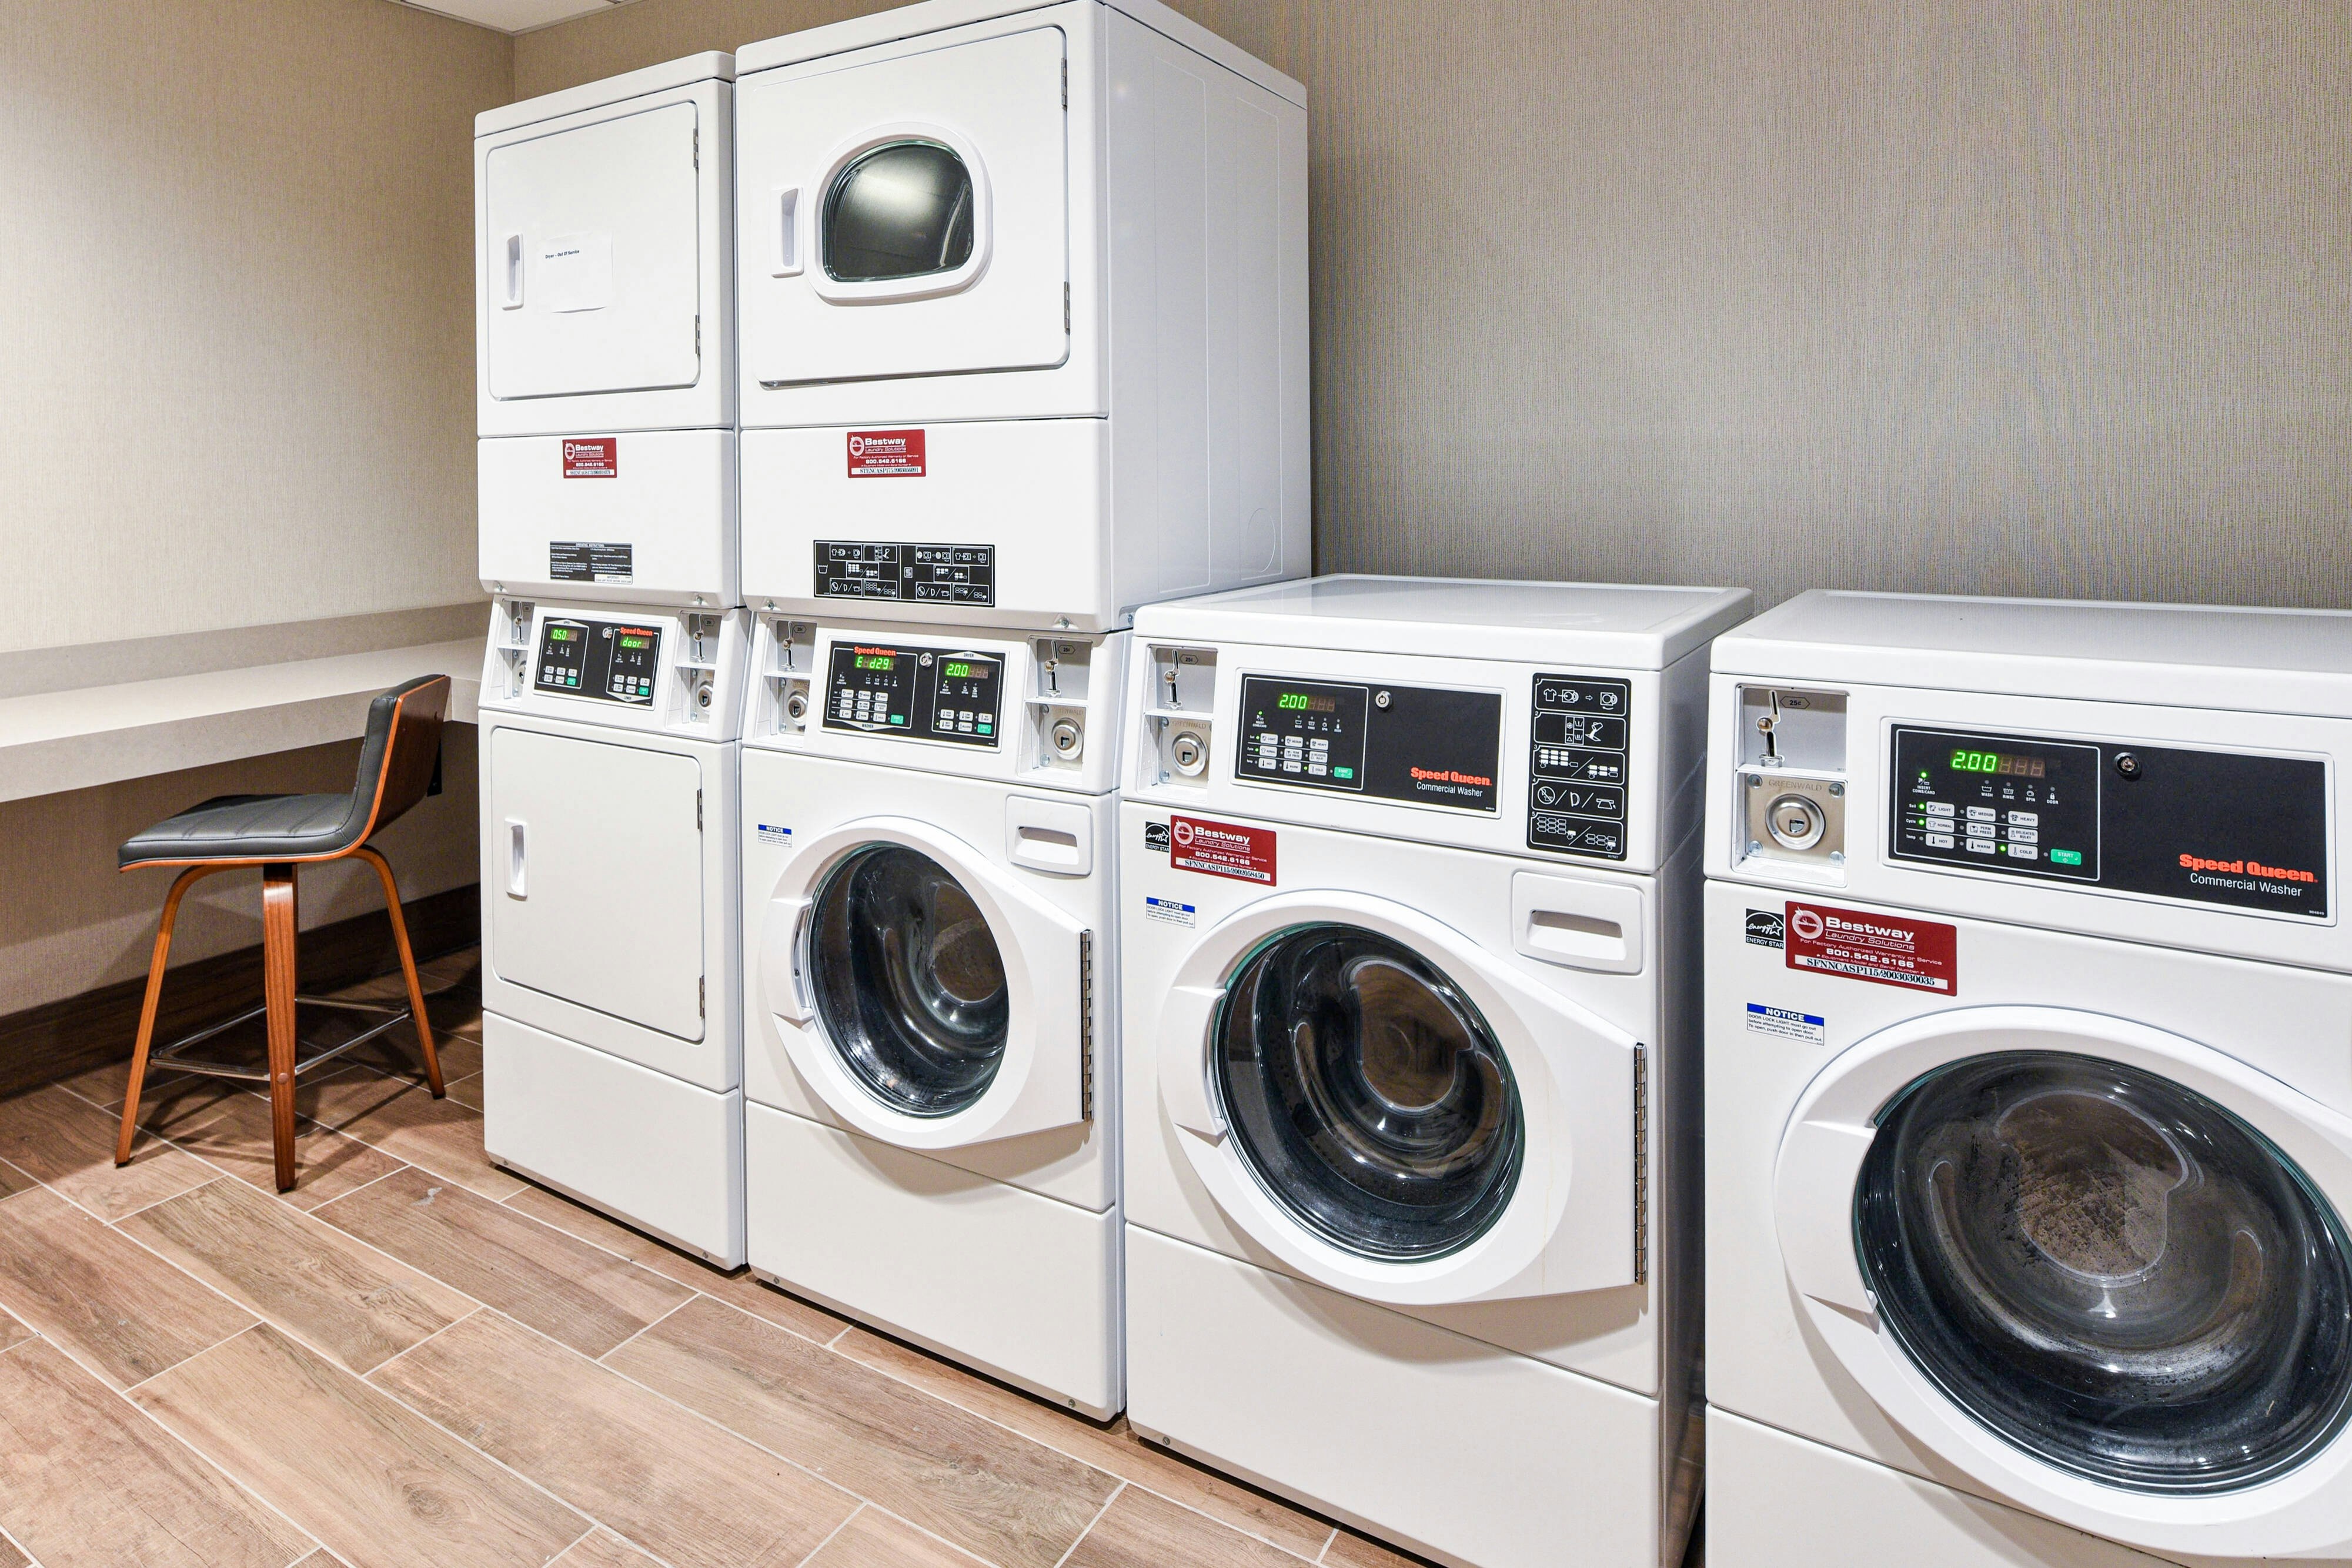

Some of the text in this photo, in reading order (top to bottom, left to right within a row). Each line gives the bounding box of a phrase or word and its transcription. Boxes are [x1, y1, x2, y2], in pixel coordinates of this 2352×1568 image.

[623, 637, 641, 647] door
[875, 647, 896, 656] Queen
[947, 664, 968, 676] 2.00
[1279, 694, 1307, 709] 2.00
[1952, 751, 1997, 772] 2.00
[1411, 767, 1491, 785] Speed Queen
[1416, 781, 1482, 797] Commercial Washer
[1769, 779, 1822, 791] GREENWALD
[1195, 826, 1250, 844] Bestway
[1195, 838, 1250, 851] Laundry Solutions
[1195, 851, 1250, 865] 800.542.6166
[2179, 854, 2314, 882] Speed Queen
[2190, 872, 2302, 897] Commercial Washer
[1158, 900, 1183, 910] NOTICE
[1825, 917, 1914, 941] Bestway
[1746, 937, 1768, 945] ENERGY
[1825, 931, 1915, 950] Laundry Solutions
[1813, 940, 1837, 950] Factory
[1839, 945, 1873, 954] Authorized
[1875, 950, 1906, 959] Warranty
[1917, 957, 1942, 965] Service
[1822, 954, 1850, 962] Equipment
[1826, 948, 1915, 968] 800.542.6166
[1807, 958, 1935, 985] SFNNCASP115/2003030035
[1766, 1008, 1805, 1022] NOTICE
[1763, 1022, 1785, 1030] attempting
